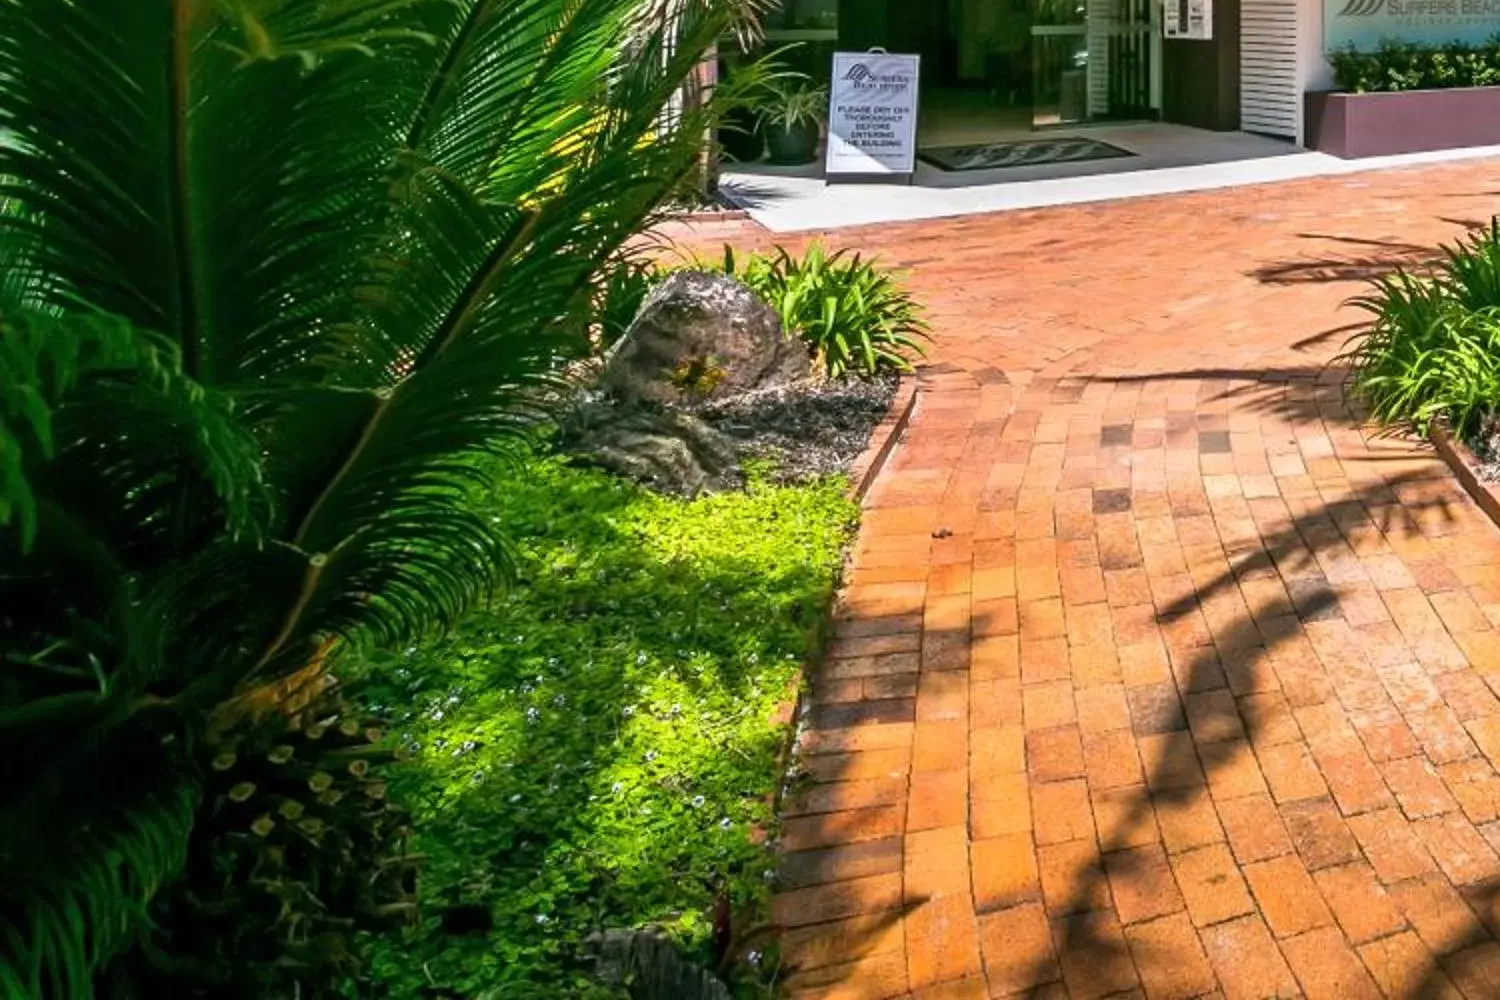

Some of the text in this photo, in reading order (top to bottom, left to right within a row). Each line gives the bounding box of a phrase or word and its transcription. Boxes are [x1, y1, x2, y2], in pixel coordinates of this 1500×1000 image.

[837, 105, 871, 114] PLEASE
[874, 105, 891, 114] DRY
[850, 131, 895, 139] ENTERING
[842, 139, 903, 147] THE BUILDING
